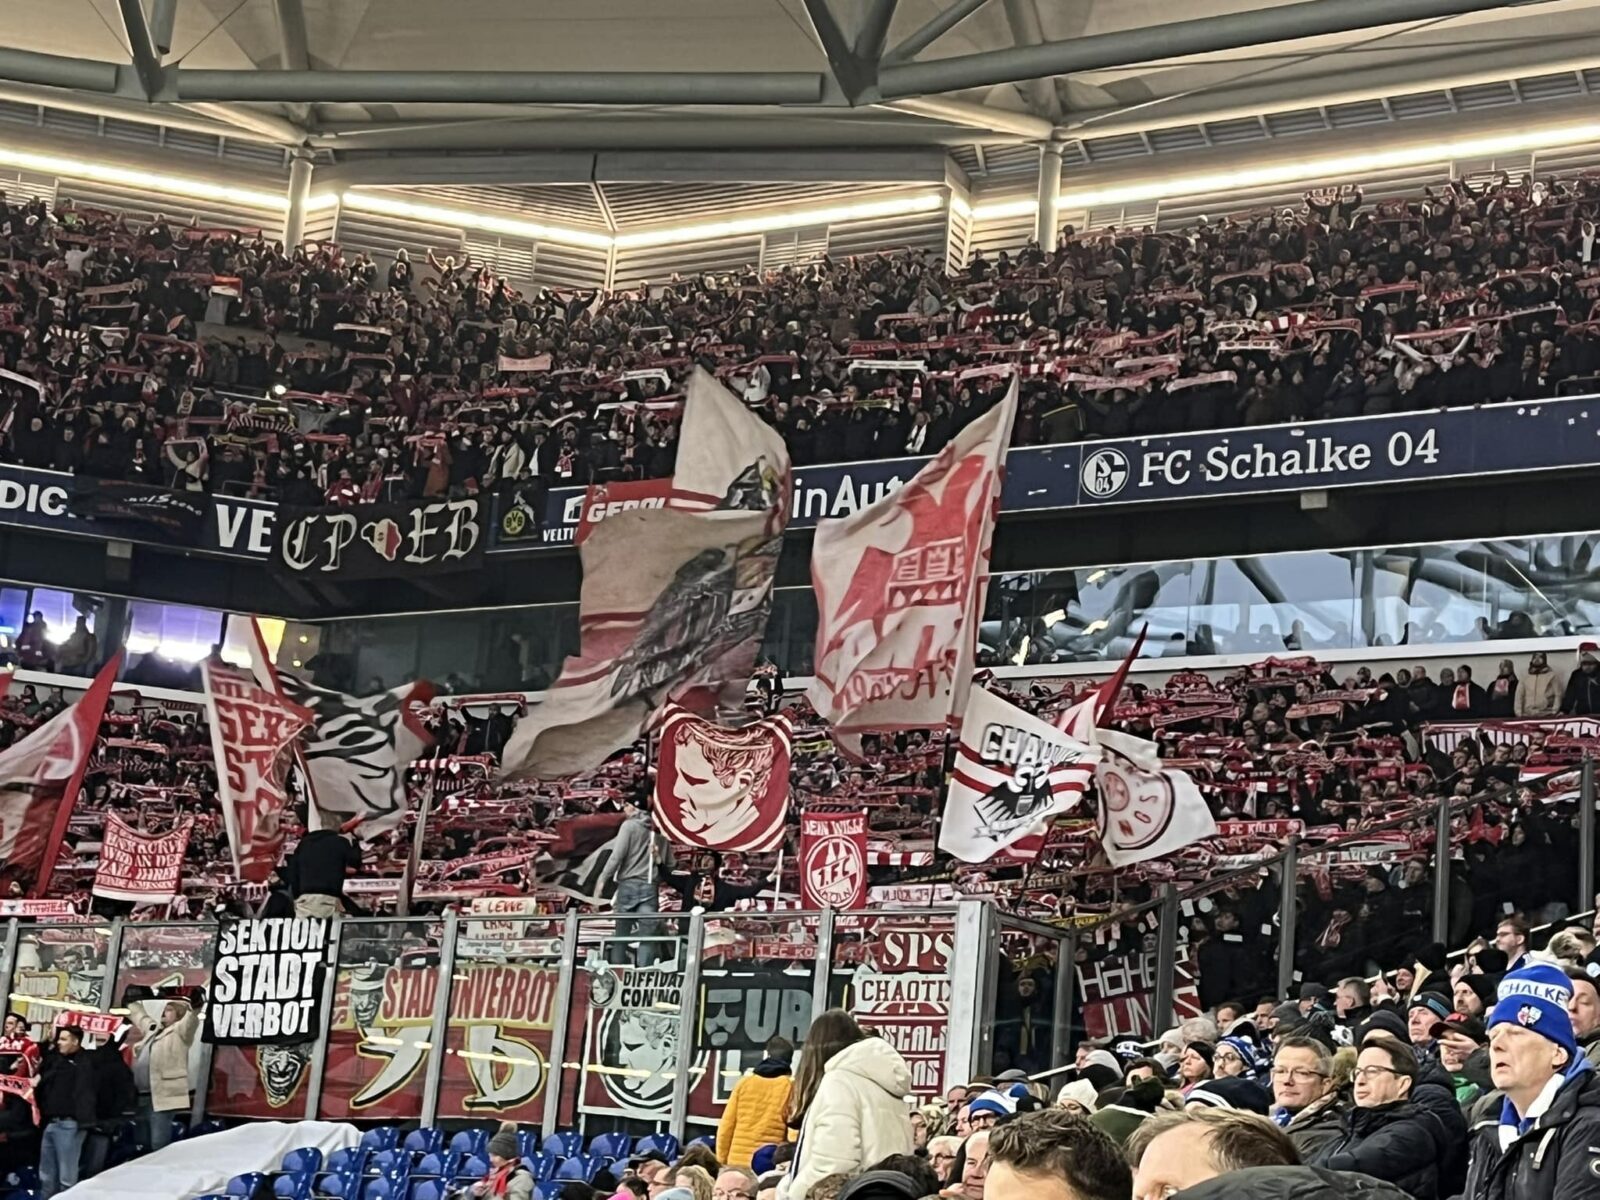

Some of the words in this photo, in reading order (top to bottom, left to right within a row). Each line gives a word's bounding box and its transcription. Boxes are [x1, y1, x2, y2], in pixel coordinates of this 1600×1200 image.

[1138, 449, 1191, 487] FC
[1205, 438, 1371, 481] Schalke
[1387, 428, 1440, 467] 04
[505, 511, 525, 527] BVB
[219, 917, 326, 955] SEKTION
[882, 932, 954, 967] SPS
[214, 951, 322, 1003] STADT
[212, 999, 315, 1039] VERBOT
